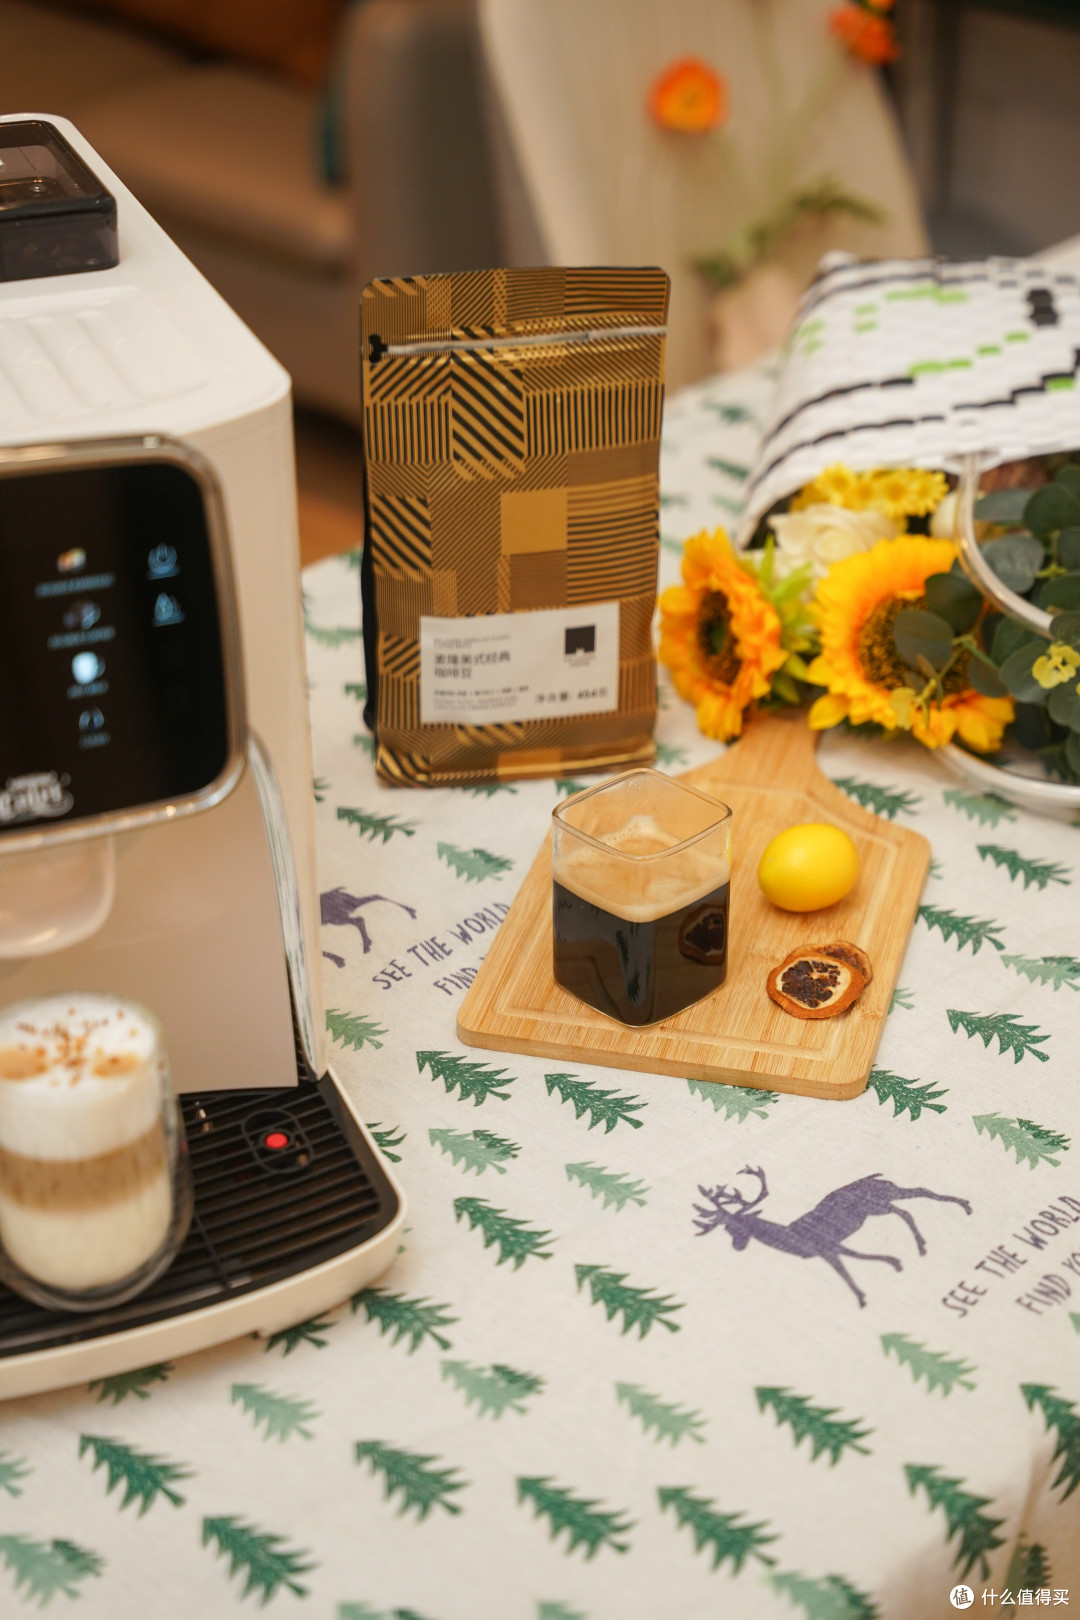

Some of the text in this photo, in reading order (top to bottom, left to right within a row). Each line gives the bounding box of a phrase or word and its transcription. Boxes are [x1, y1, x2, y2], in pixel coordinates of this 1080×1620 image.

[372, 959, 413, 990] SEE
[406, 936, 454, 967] THE
[942, 1196, 1080, 1319] SEE THE WORLD
[1015, 1274, 1072, 1315] FIND
